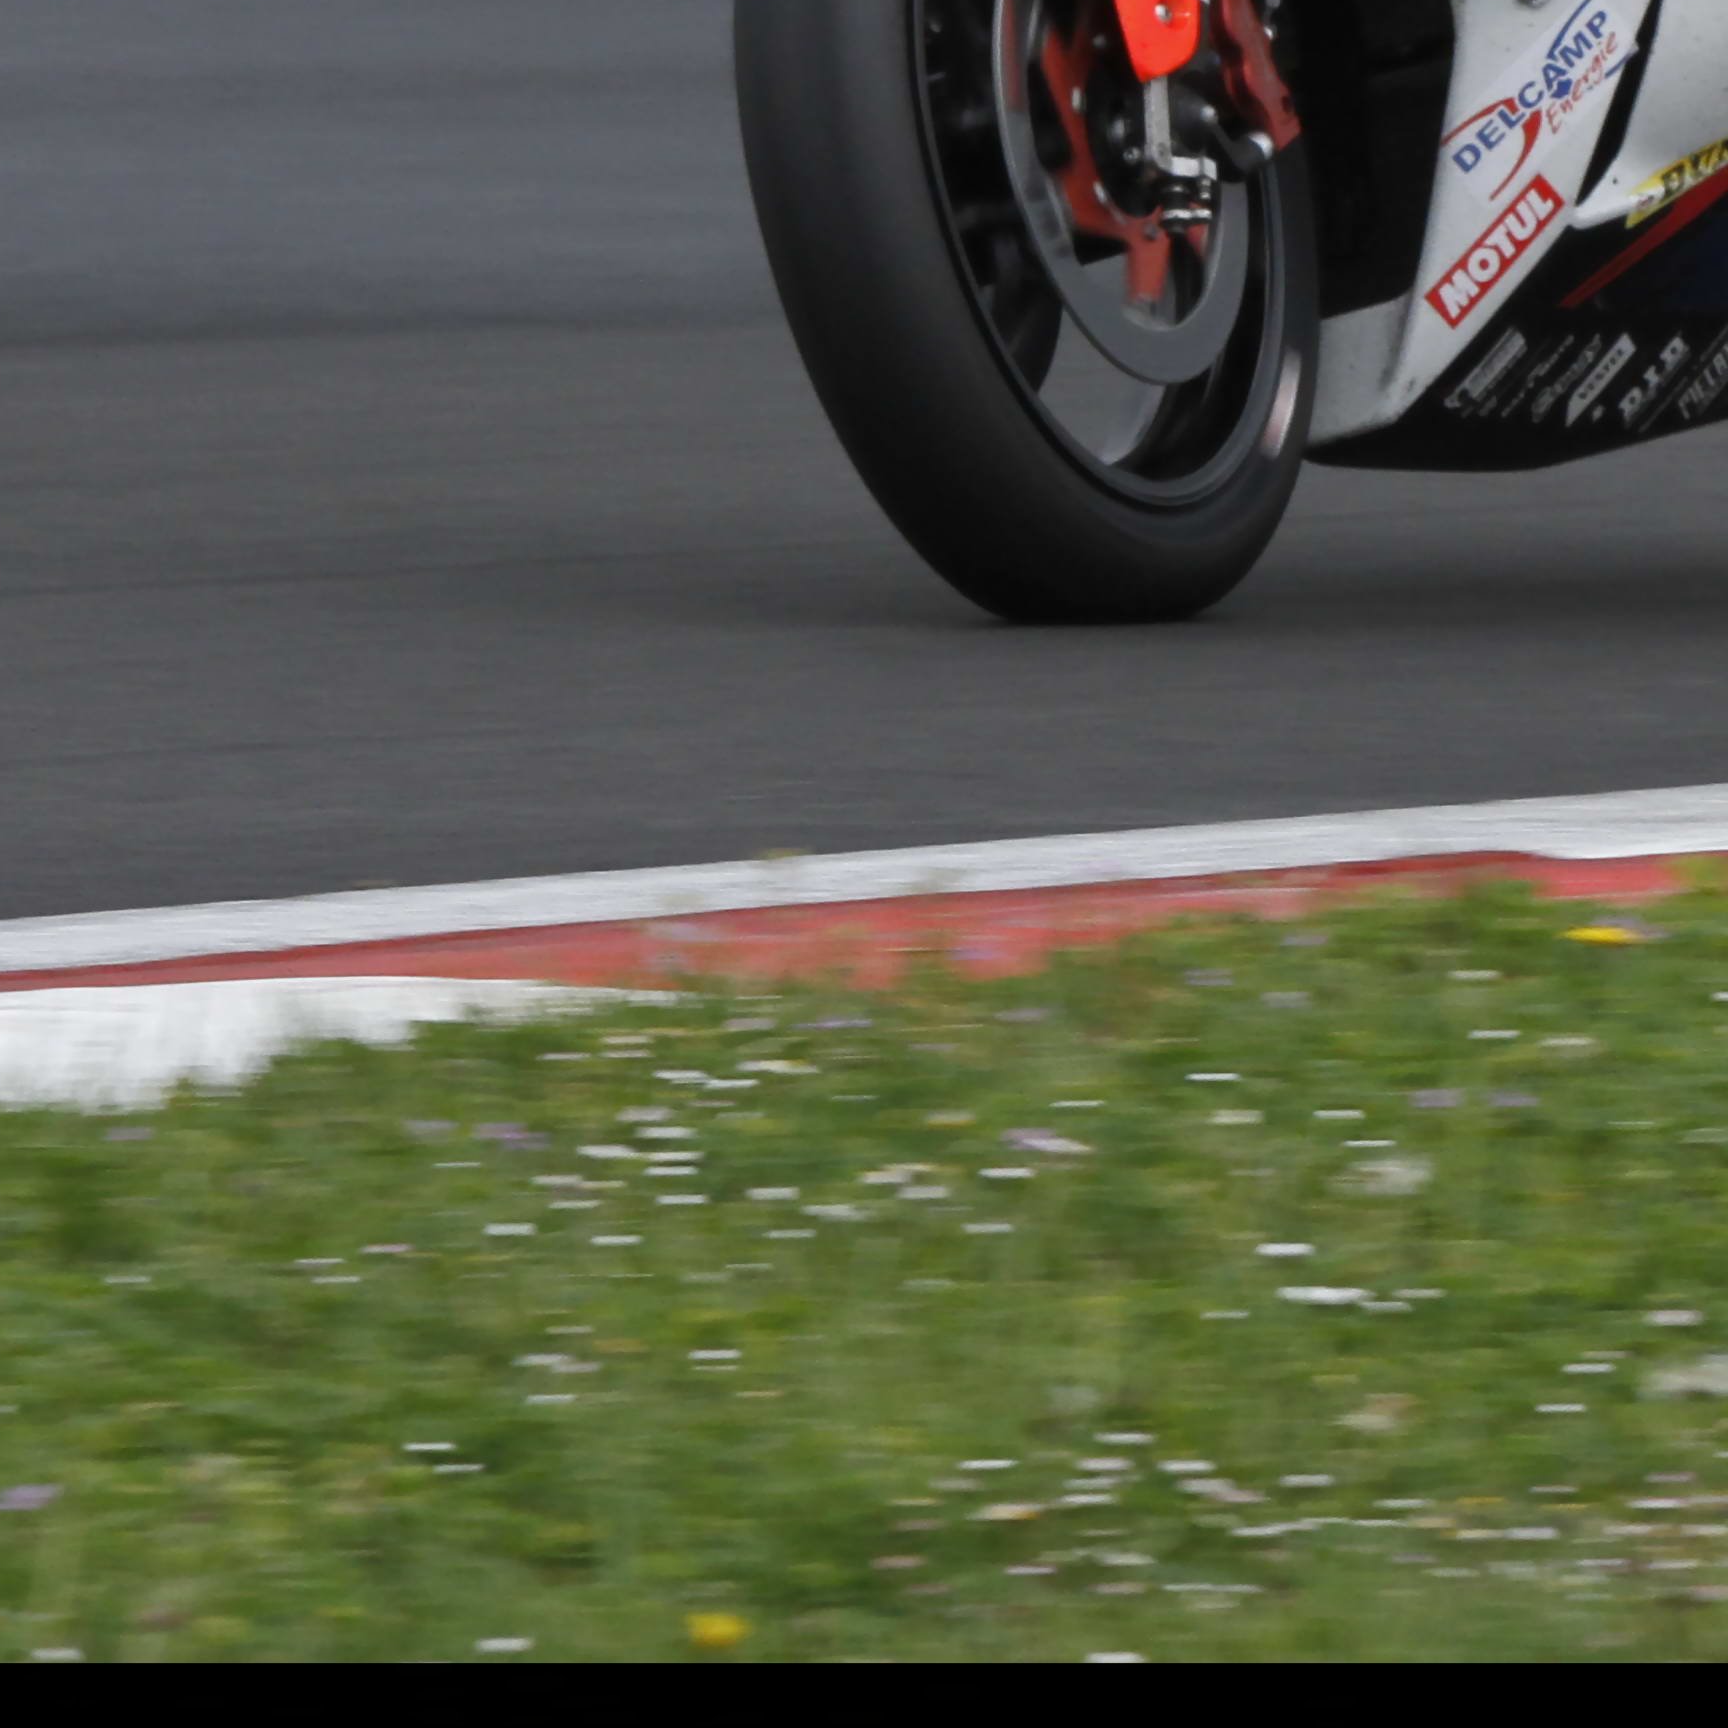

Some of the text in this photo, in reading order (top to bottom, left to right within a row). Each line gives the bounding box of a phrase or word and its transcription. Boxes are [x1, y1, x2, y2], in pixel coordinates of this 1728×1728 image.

[1451, 9, 1609, 175] DELCAMP
[1545, 31, 1618, 135] Energie
[1438, 188, 1556, 319] MOTUL
